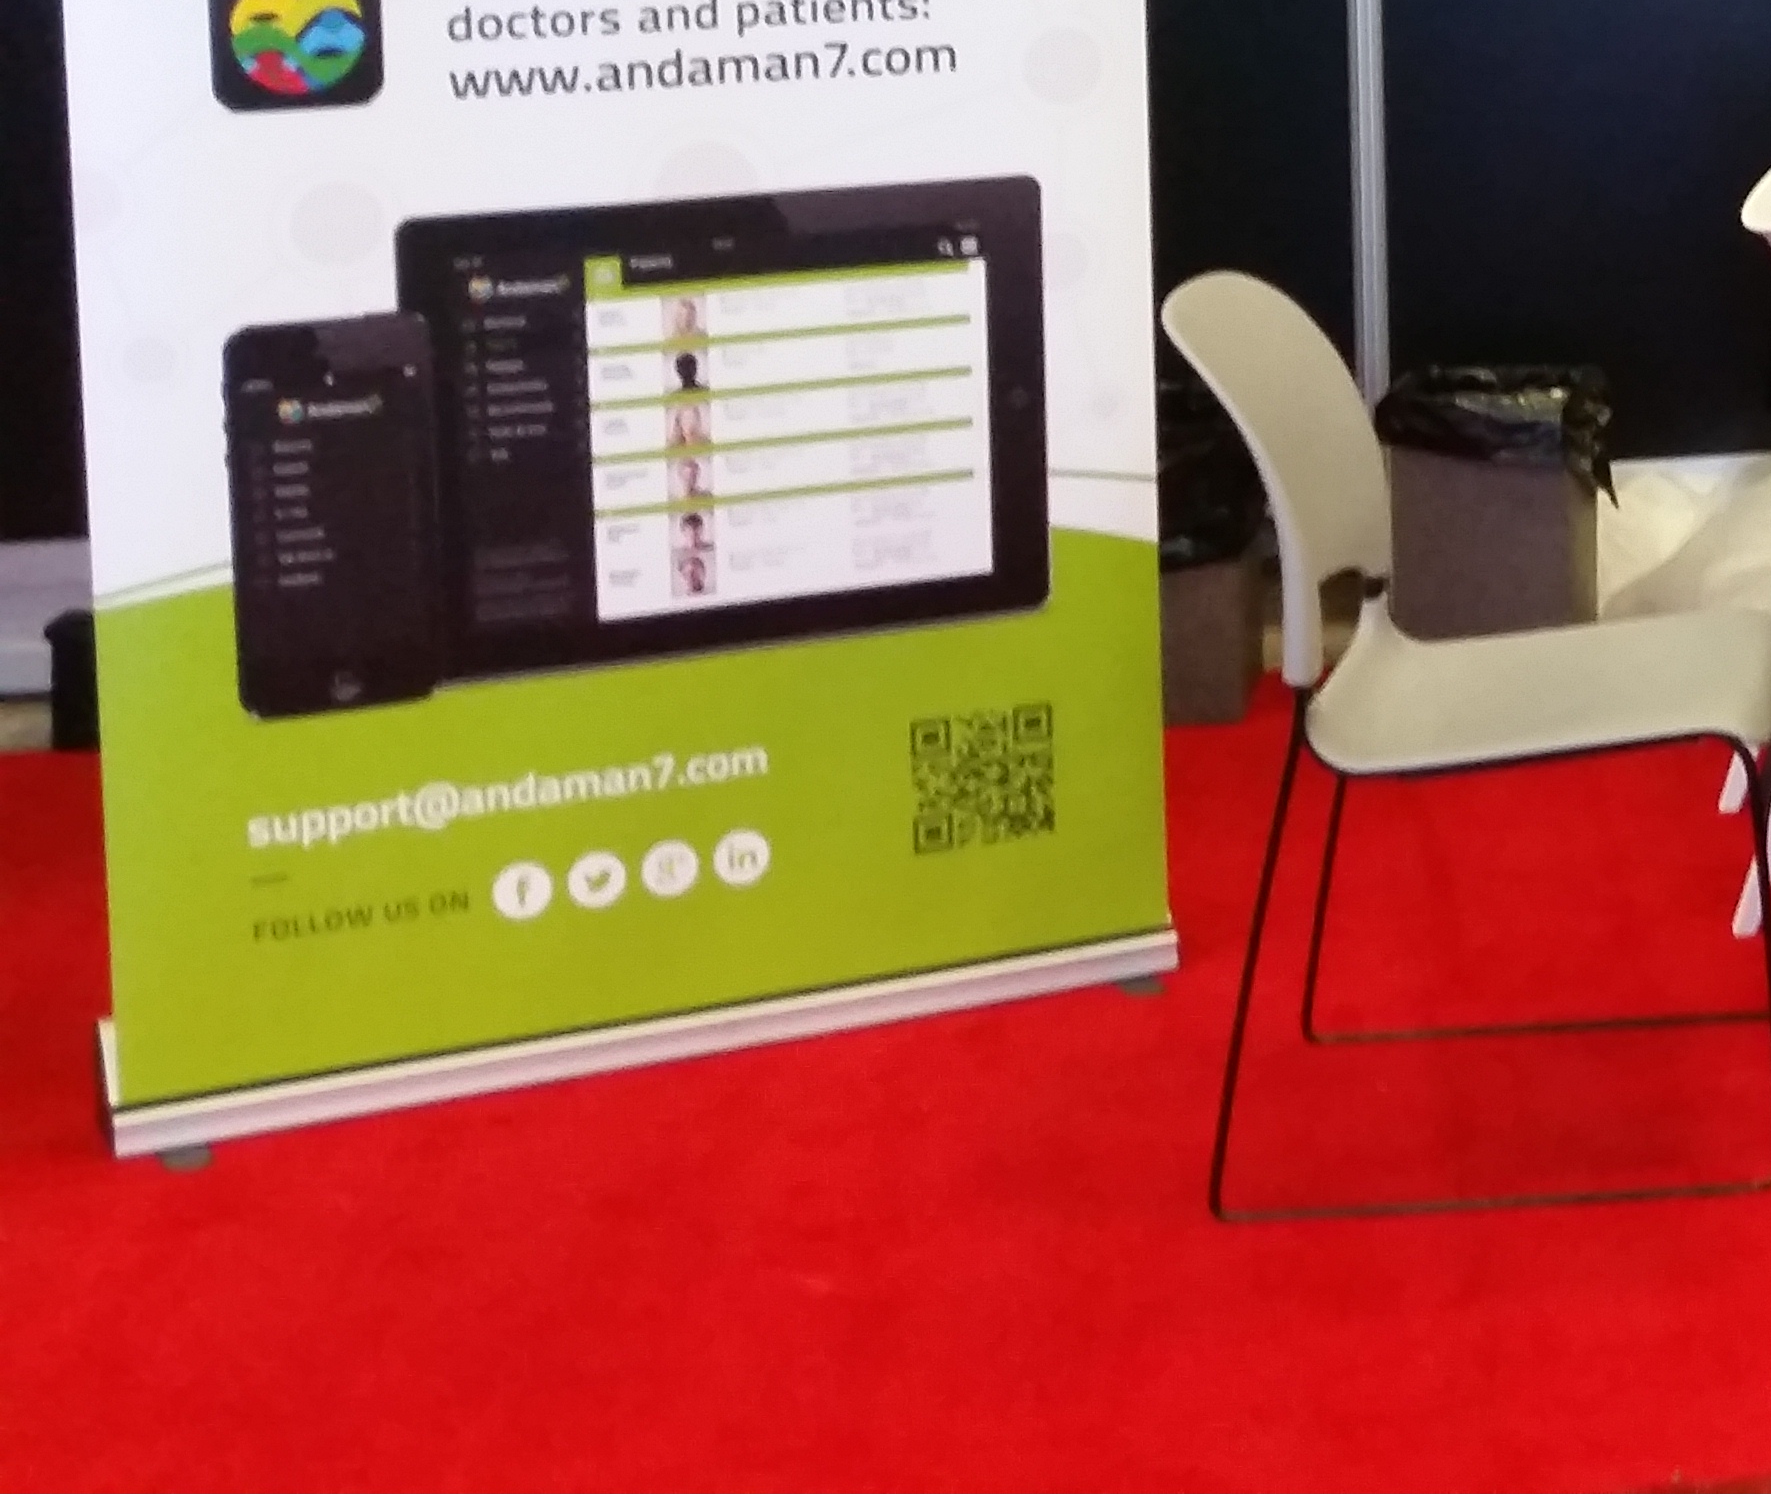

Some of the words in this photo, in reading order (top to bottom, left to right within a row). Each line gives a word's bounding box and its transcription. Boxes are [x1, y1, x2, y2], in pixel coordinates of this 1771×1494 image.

[447, 2, 621, 42] doctors
[449, 40, 958, 100] www.andaman7.com
[247, 745, 769, 849] support@andaman7.com
[253, 905, 374, 941] FOLLOW
[384, 898, 420, 922] US
[429, 891, 470, 914] ON
